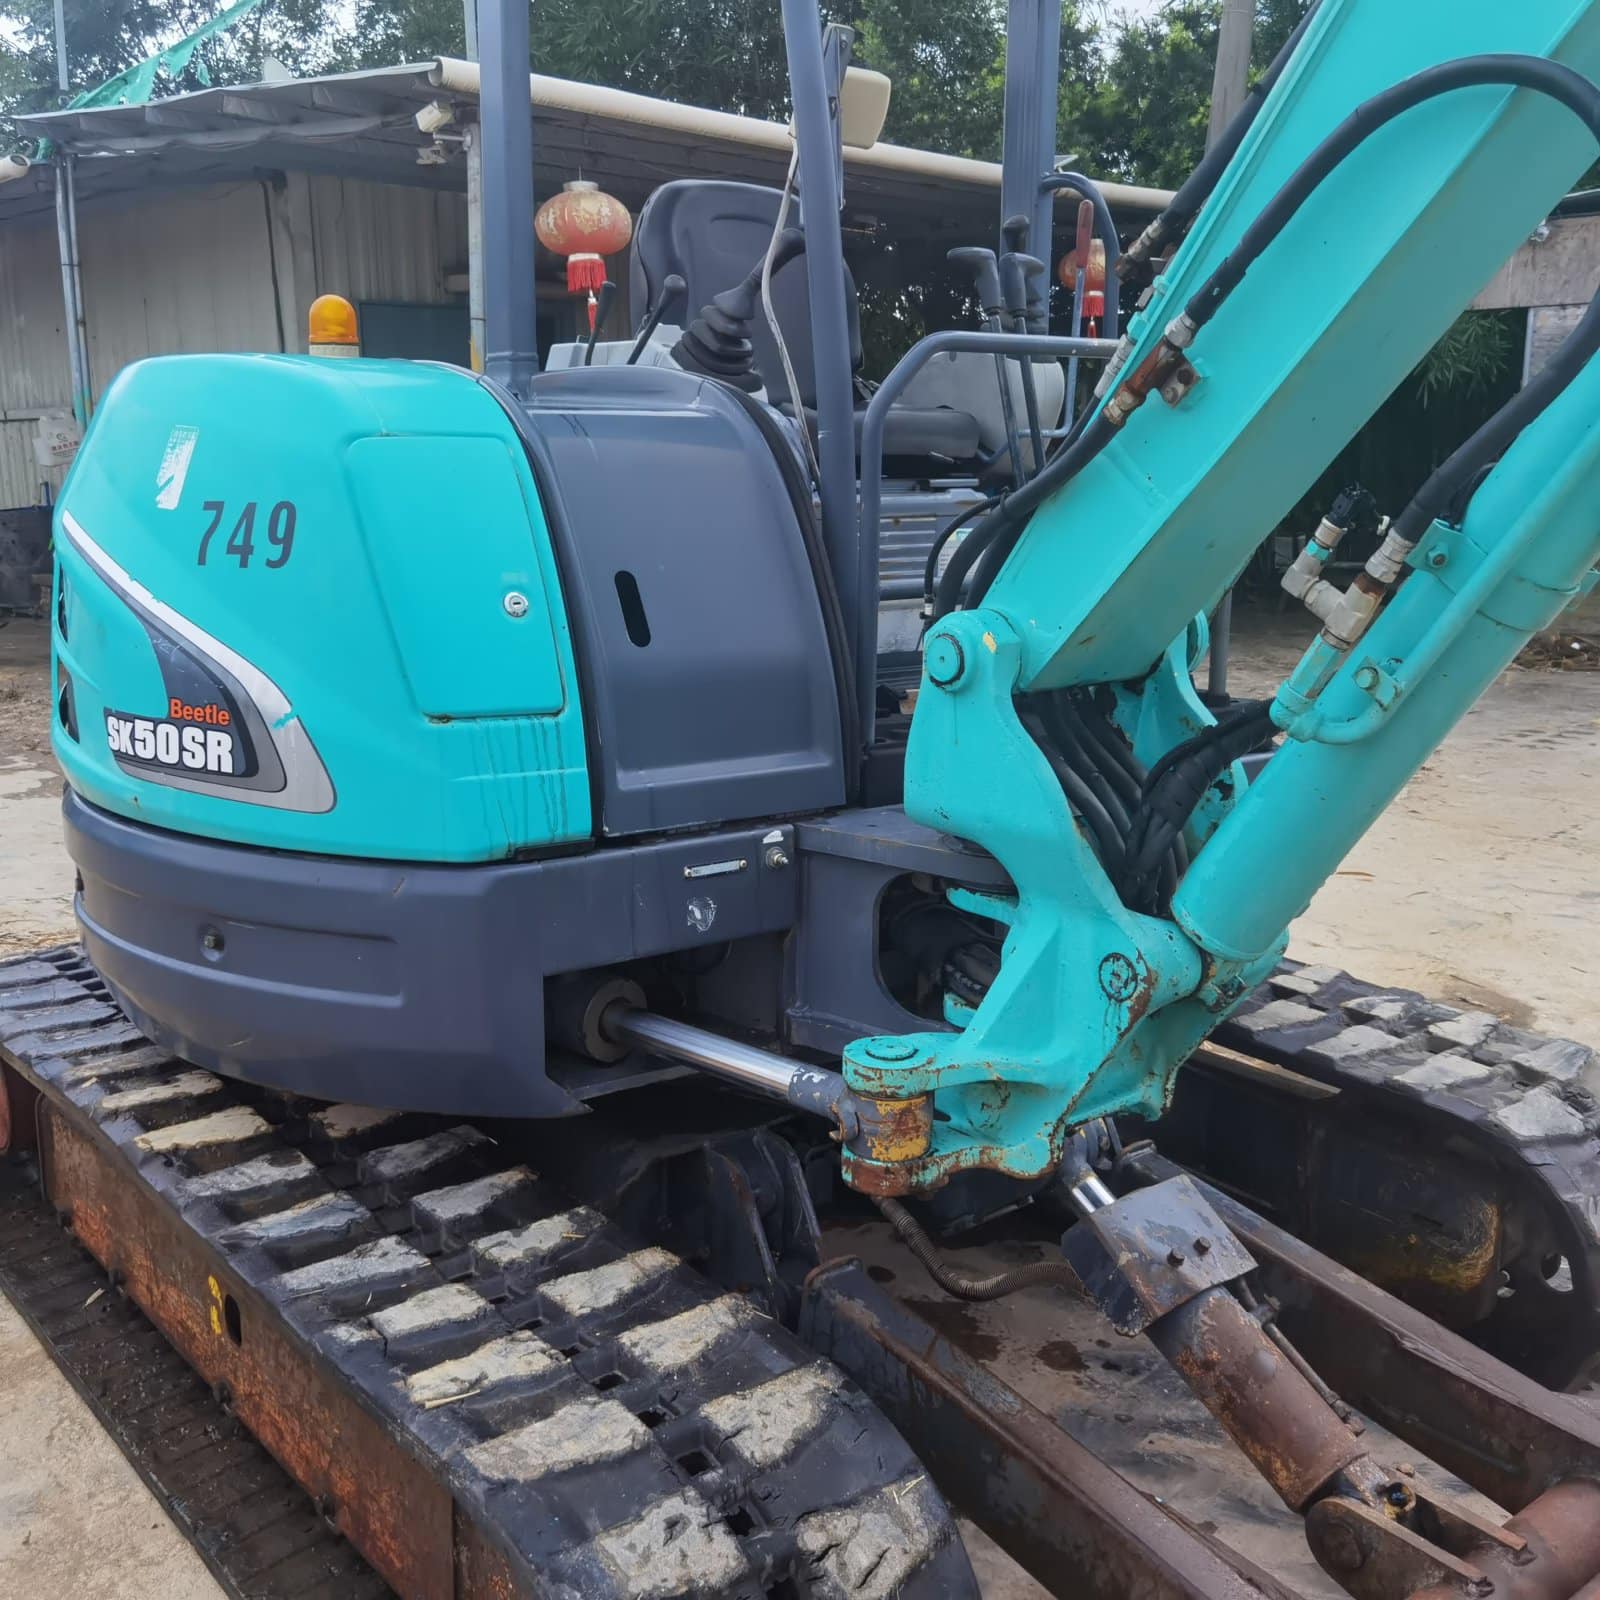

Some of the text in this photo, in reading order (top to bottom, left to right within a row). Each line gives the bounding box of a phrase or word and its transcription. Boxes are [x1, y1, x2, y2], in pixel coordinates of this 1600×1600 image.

[198, 501, 296, 568] 749
[170, 699, 230, 725] Beetle
[107, 716, 233, 774] SK50SR
